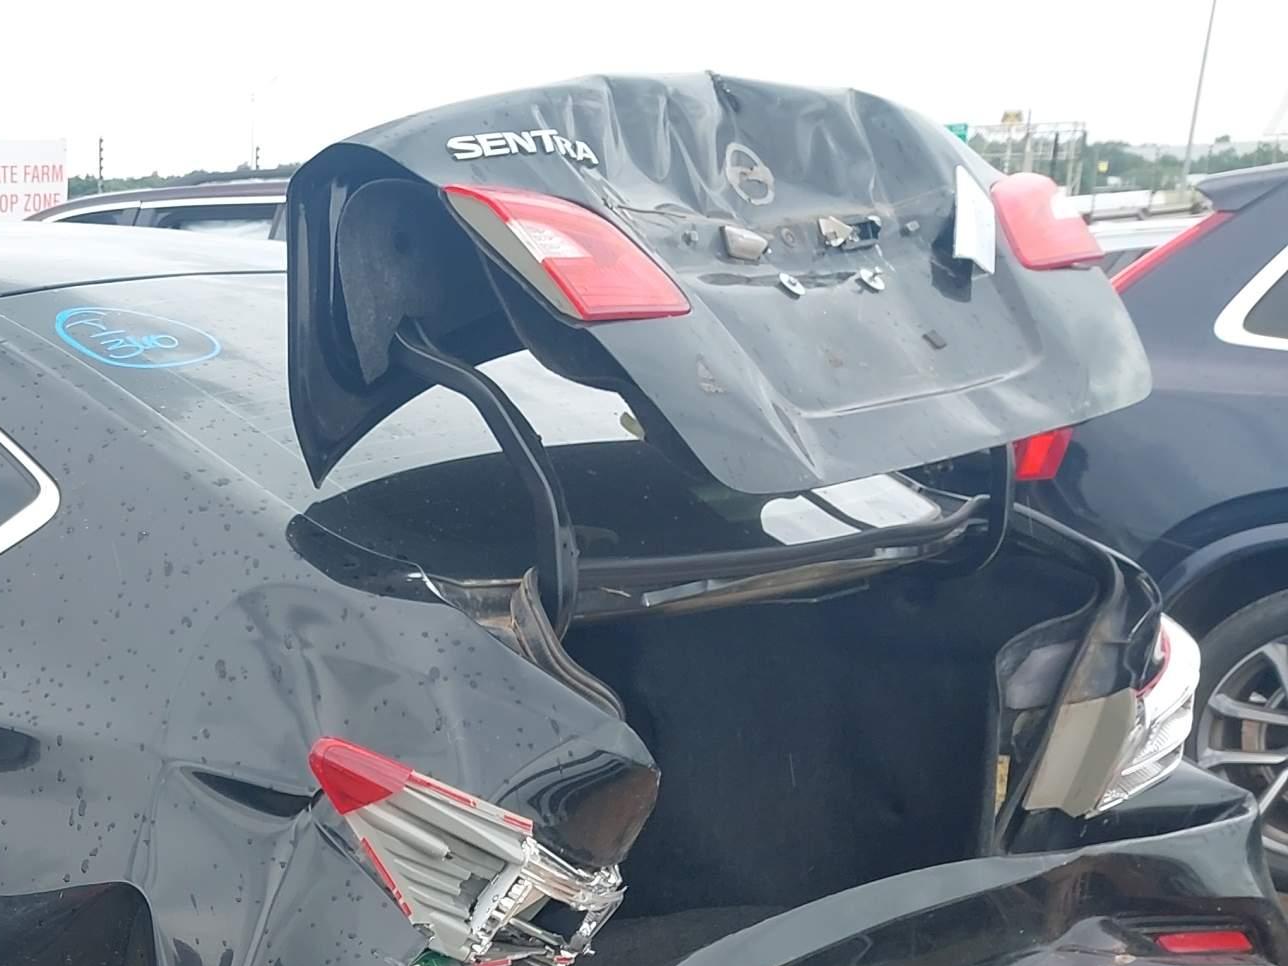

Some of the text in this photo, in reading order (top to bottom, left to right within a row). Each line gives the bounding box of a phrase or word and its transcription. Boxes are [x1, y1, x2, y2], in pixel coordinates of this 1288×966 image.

[446, 129, 600, 166] SENTRA
[24, 164, 64, 183] FARM
[24, 193, 61, 212] ZONE
